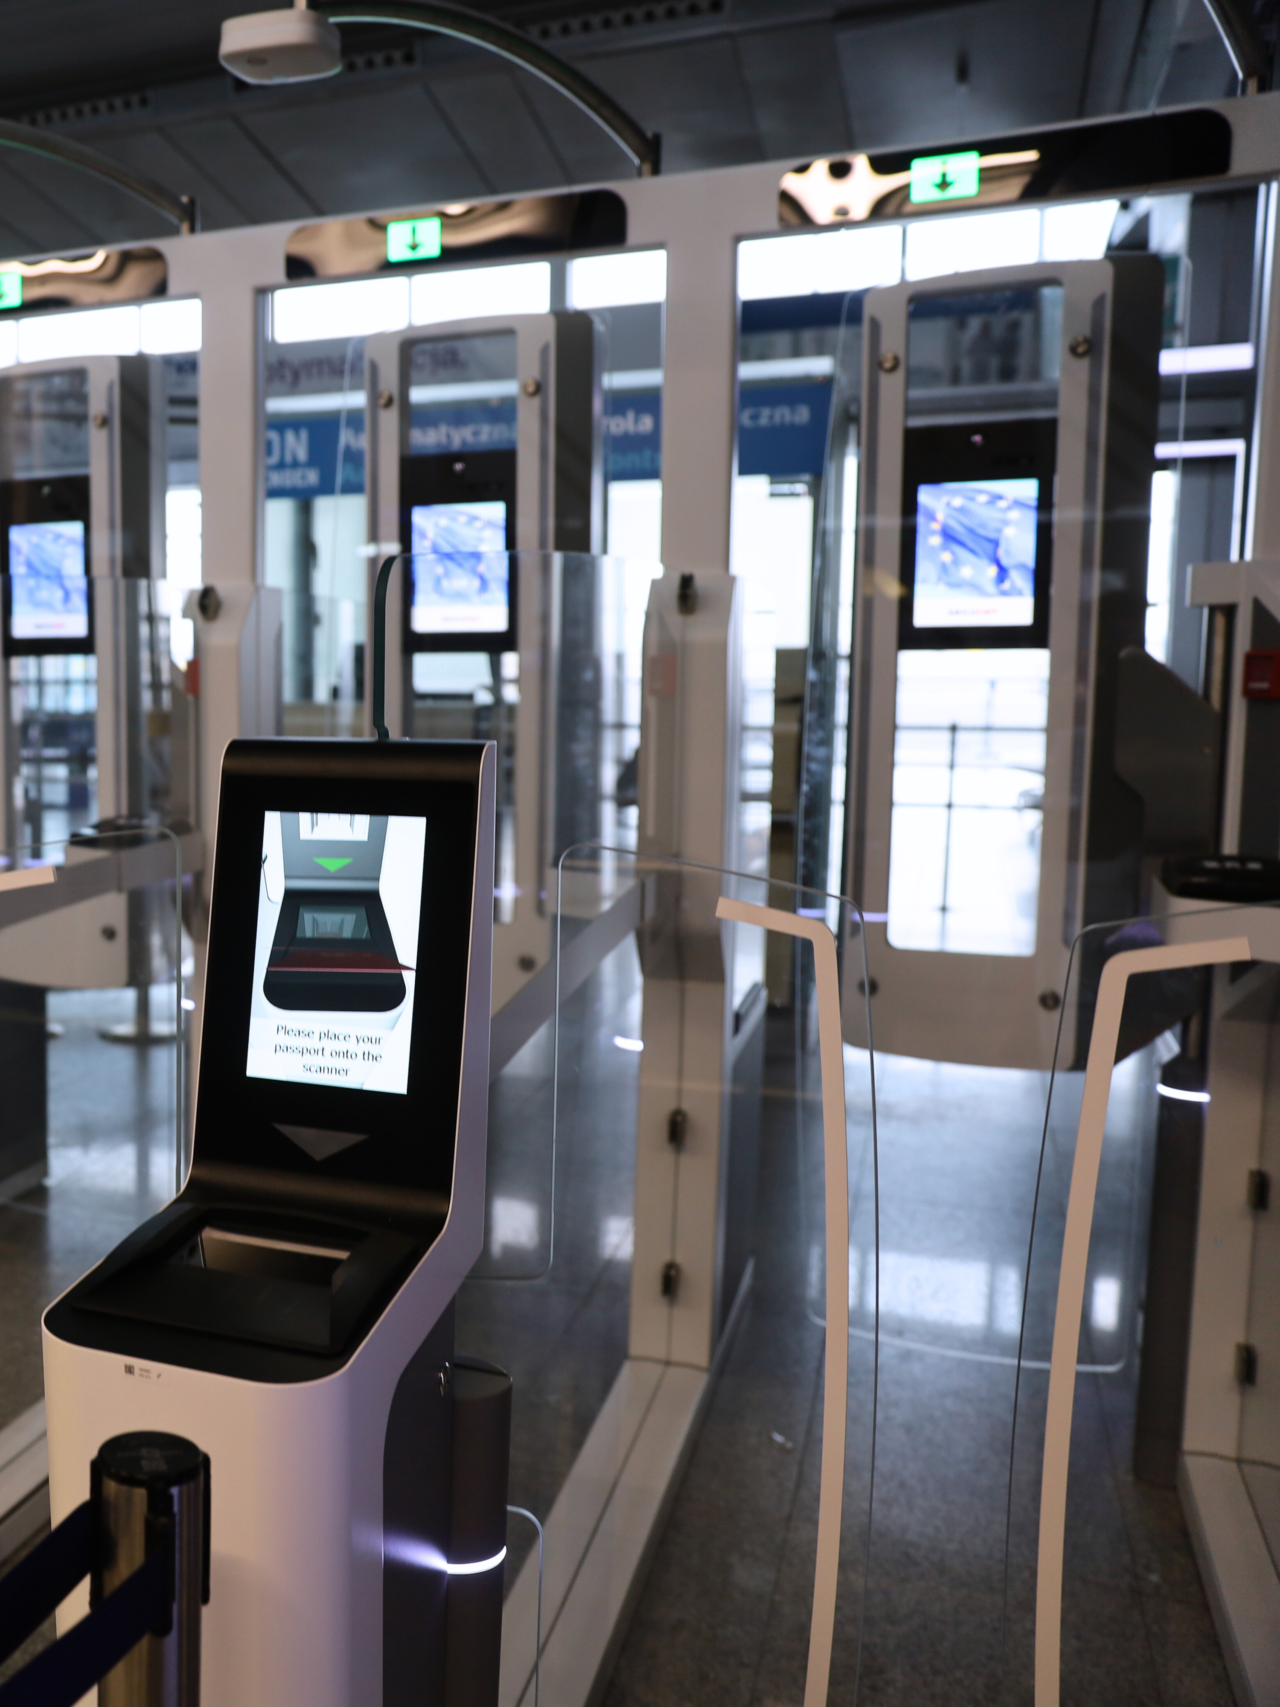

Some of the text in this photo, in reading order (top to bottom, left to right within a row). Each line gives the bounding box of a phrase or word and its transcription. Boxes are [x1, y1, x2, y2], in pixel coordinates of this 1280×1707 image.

[276, 1023, 382, 1046] Please place your
[274, 1042, 382, 1063] passport onto the
[302, 1062, 350, 1077] scanner
